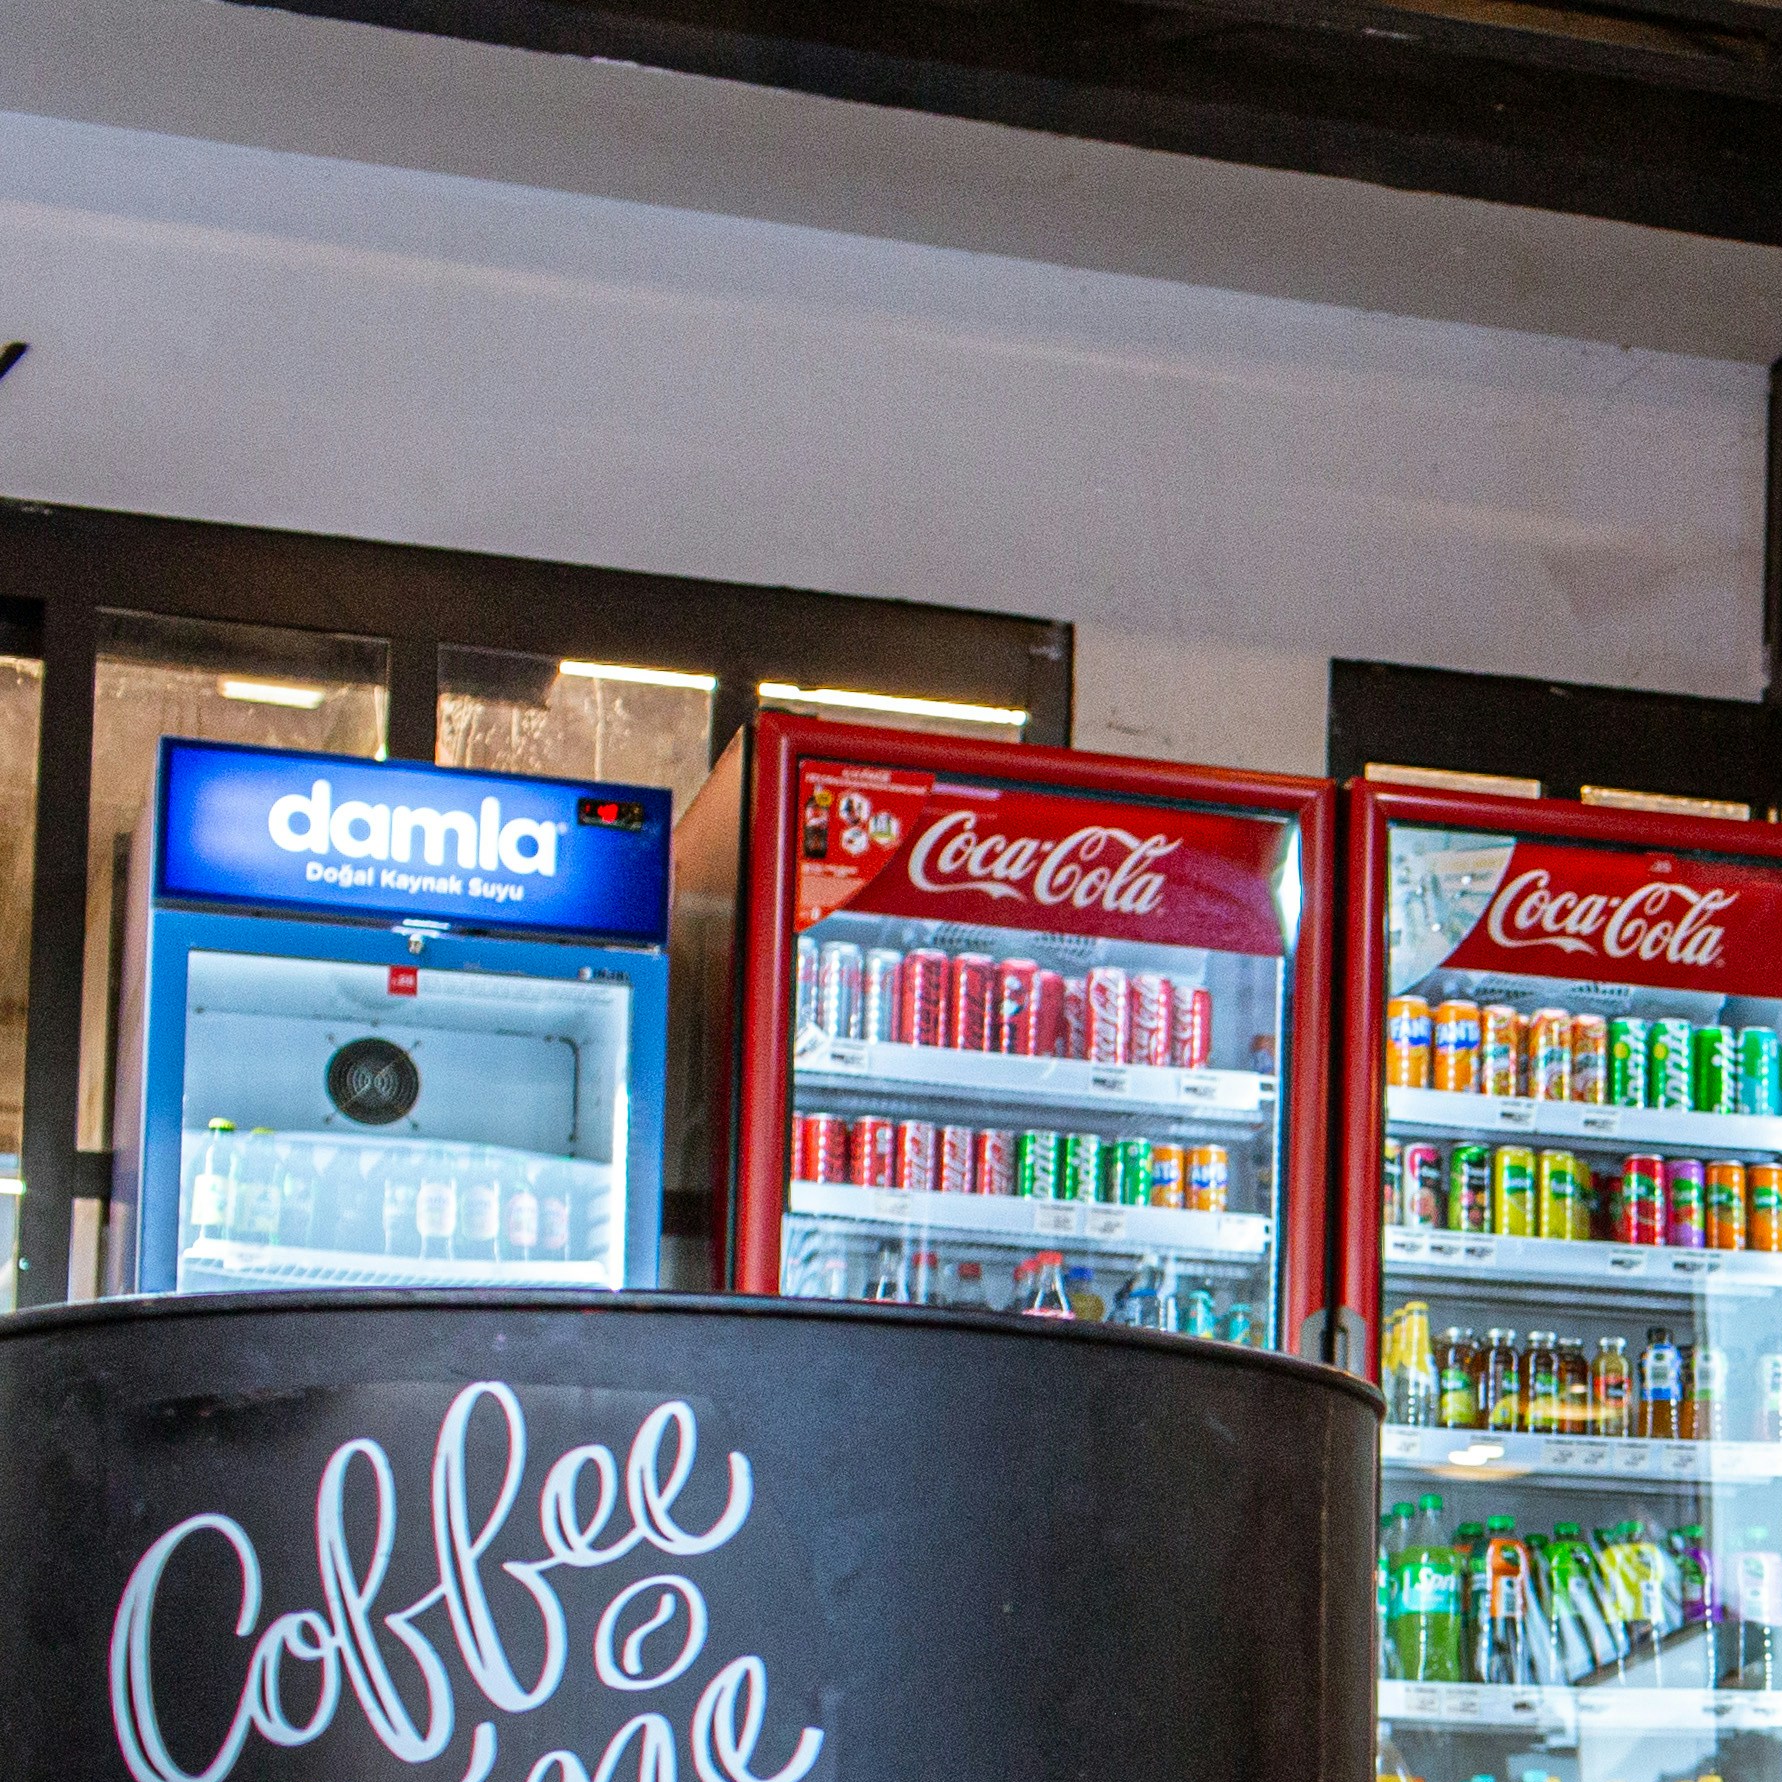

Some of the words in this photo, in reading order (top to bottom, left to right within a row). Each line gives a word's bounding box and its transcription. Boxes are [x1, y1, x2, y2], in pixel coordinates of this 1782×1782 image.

[268, 779, 557, 876] damla
[907, 810, 1182, 915] Coca-Cola
[306, 861, 373, 887] Doğal
[380, 870, 462, 895] Kaynak
[468, 877, 525, 902] Suyu
[1487, 869, 1740, 966] Coca-Cola
